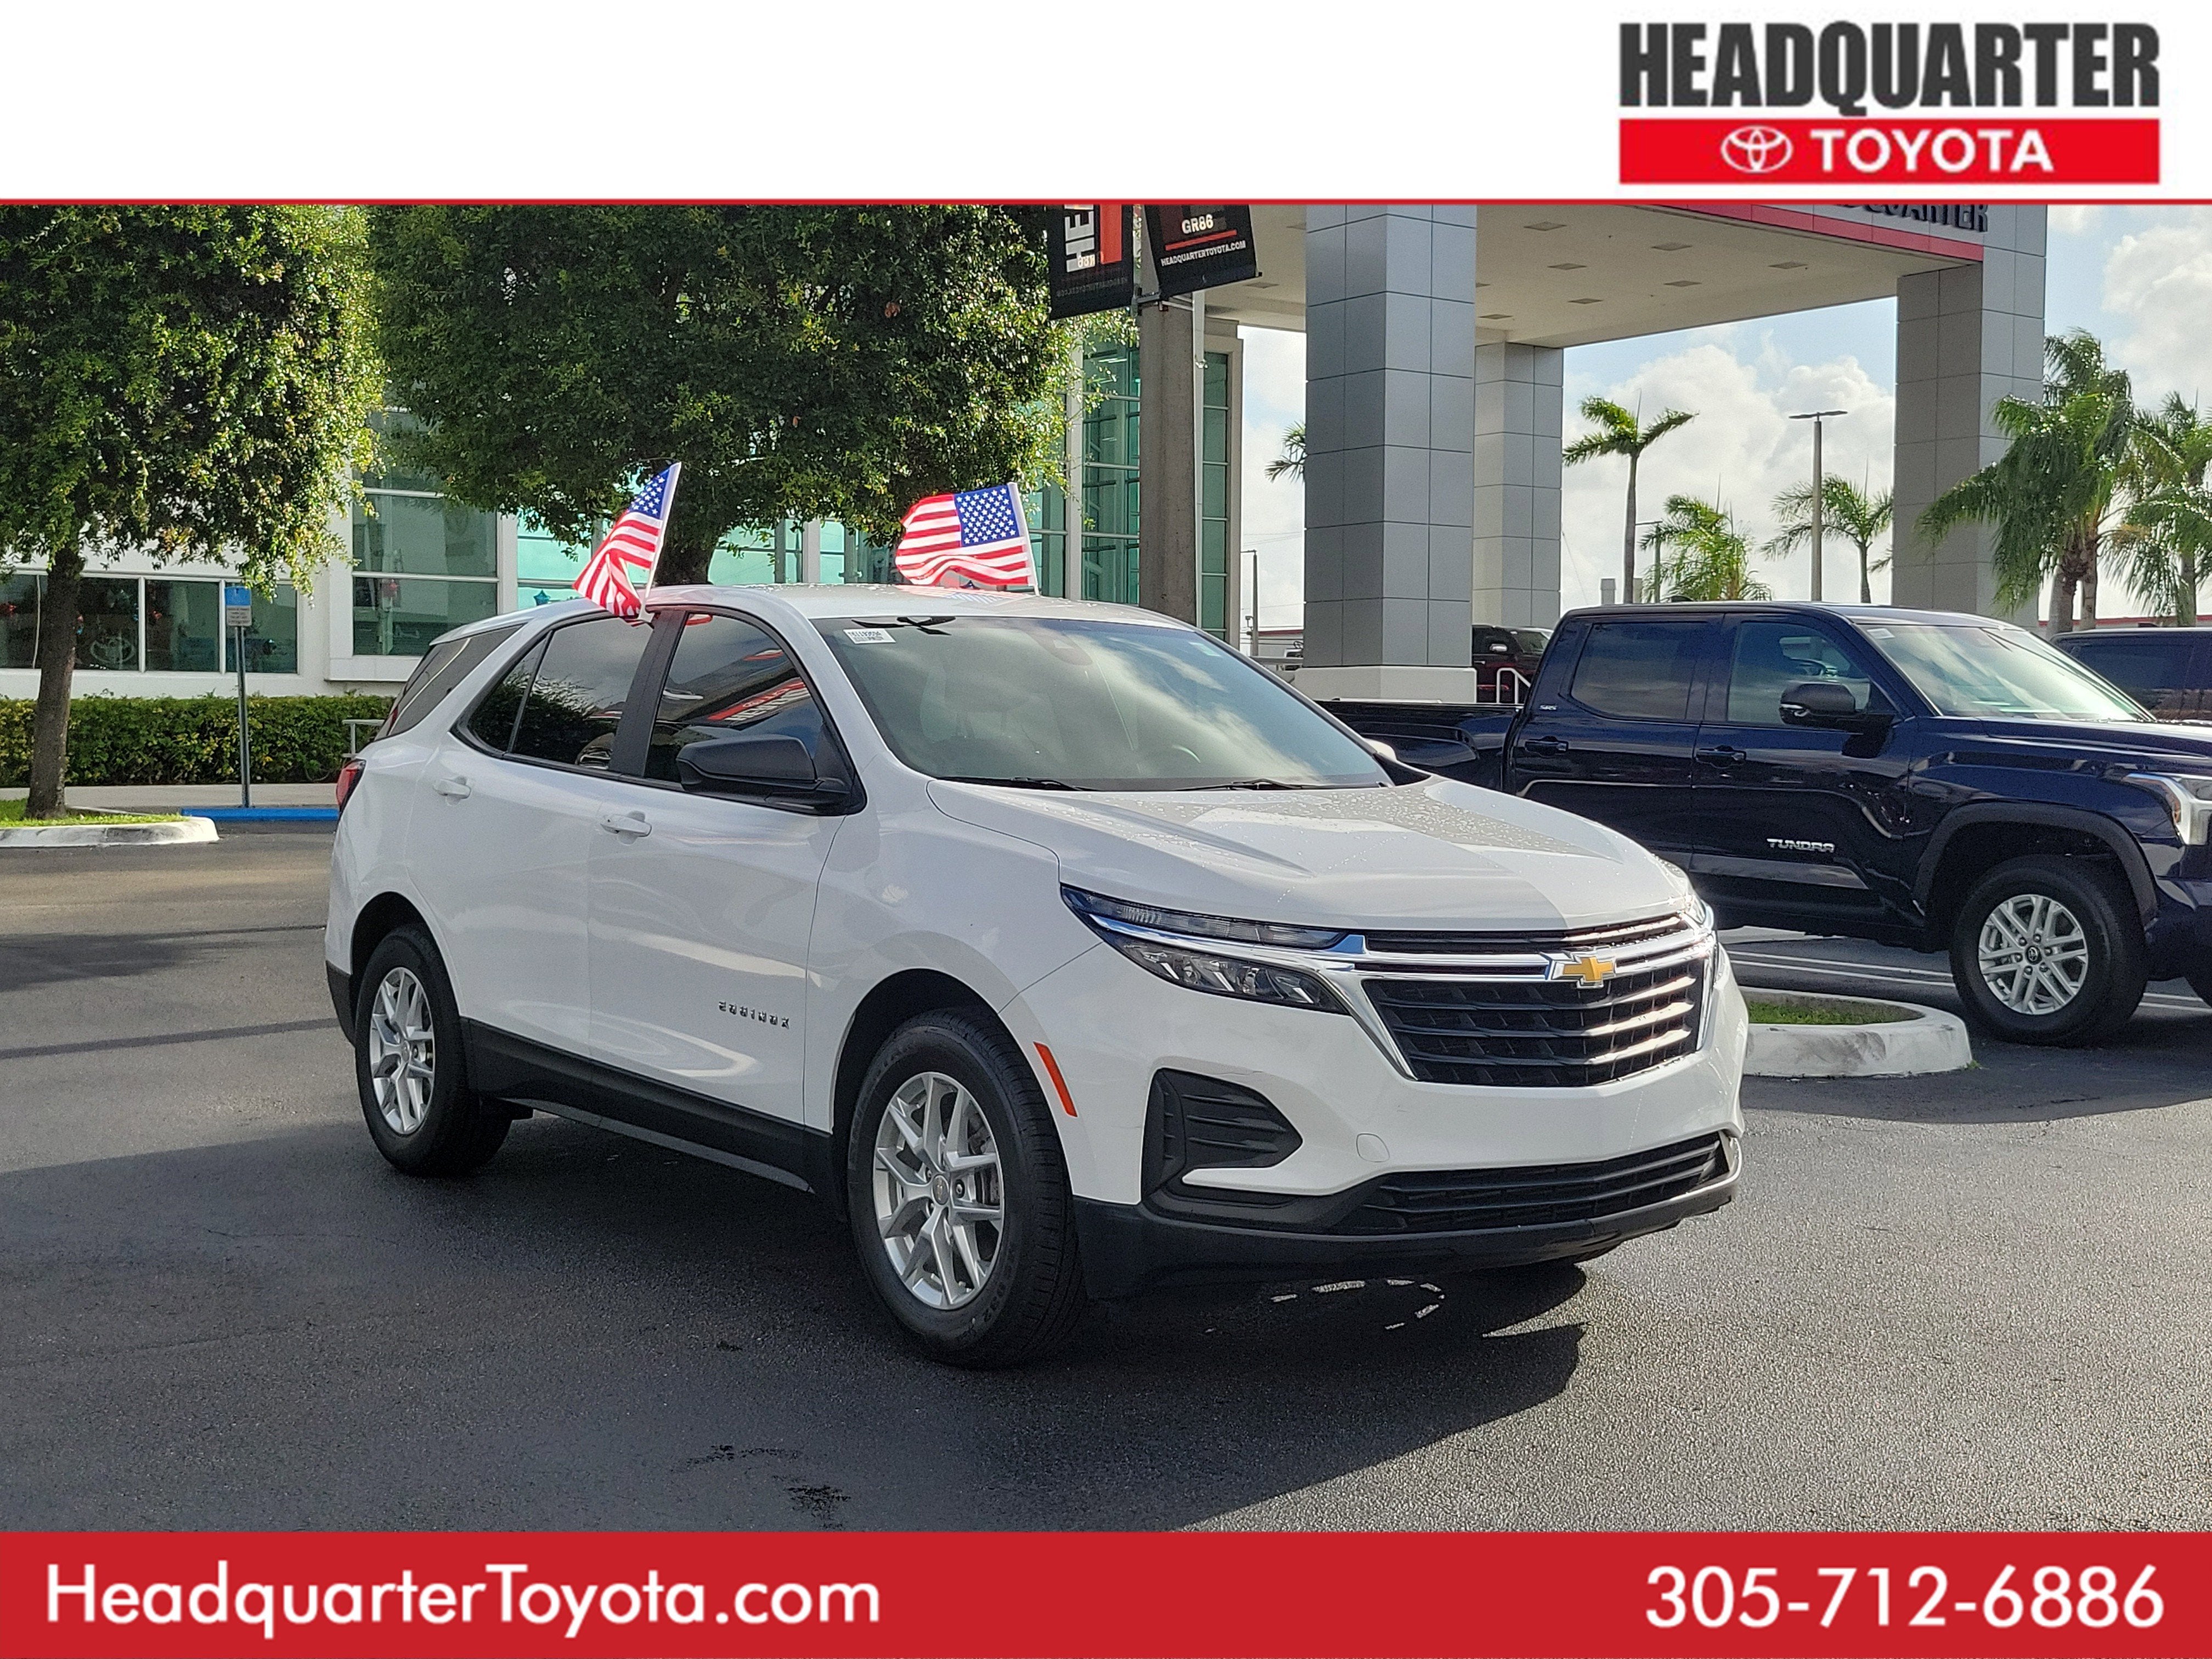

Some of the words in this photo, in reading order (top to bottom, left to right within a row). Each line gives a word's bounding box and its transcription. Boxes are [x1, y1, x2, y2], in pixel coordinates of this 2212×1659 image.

[1181, 214, 1214, 234] GR86
[1160, 240, 1246, 267] HEADQUARTERTOYOTA.COM
[1767, 838, 1835, 853] TUNDRA
[718, 1001, 789, 1030] EQUINOX
